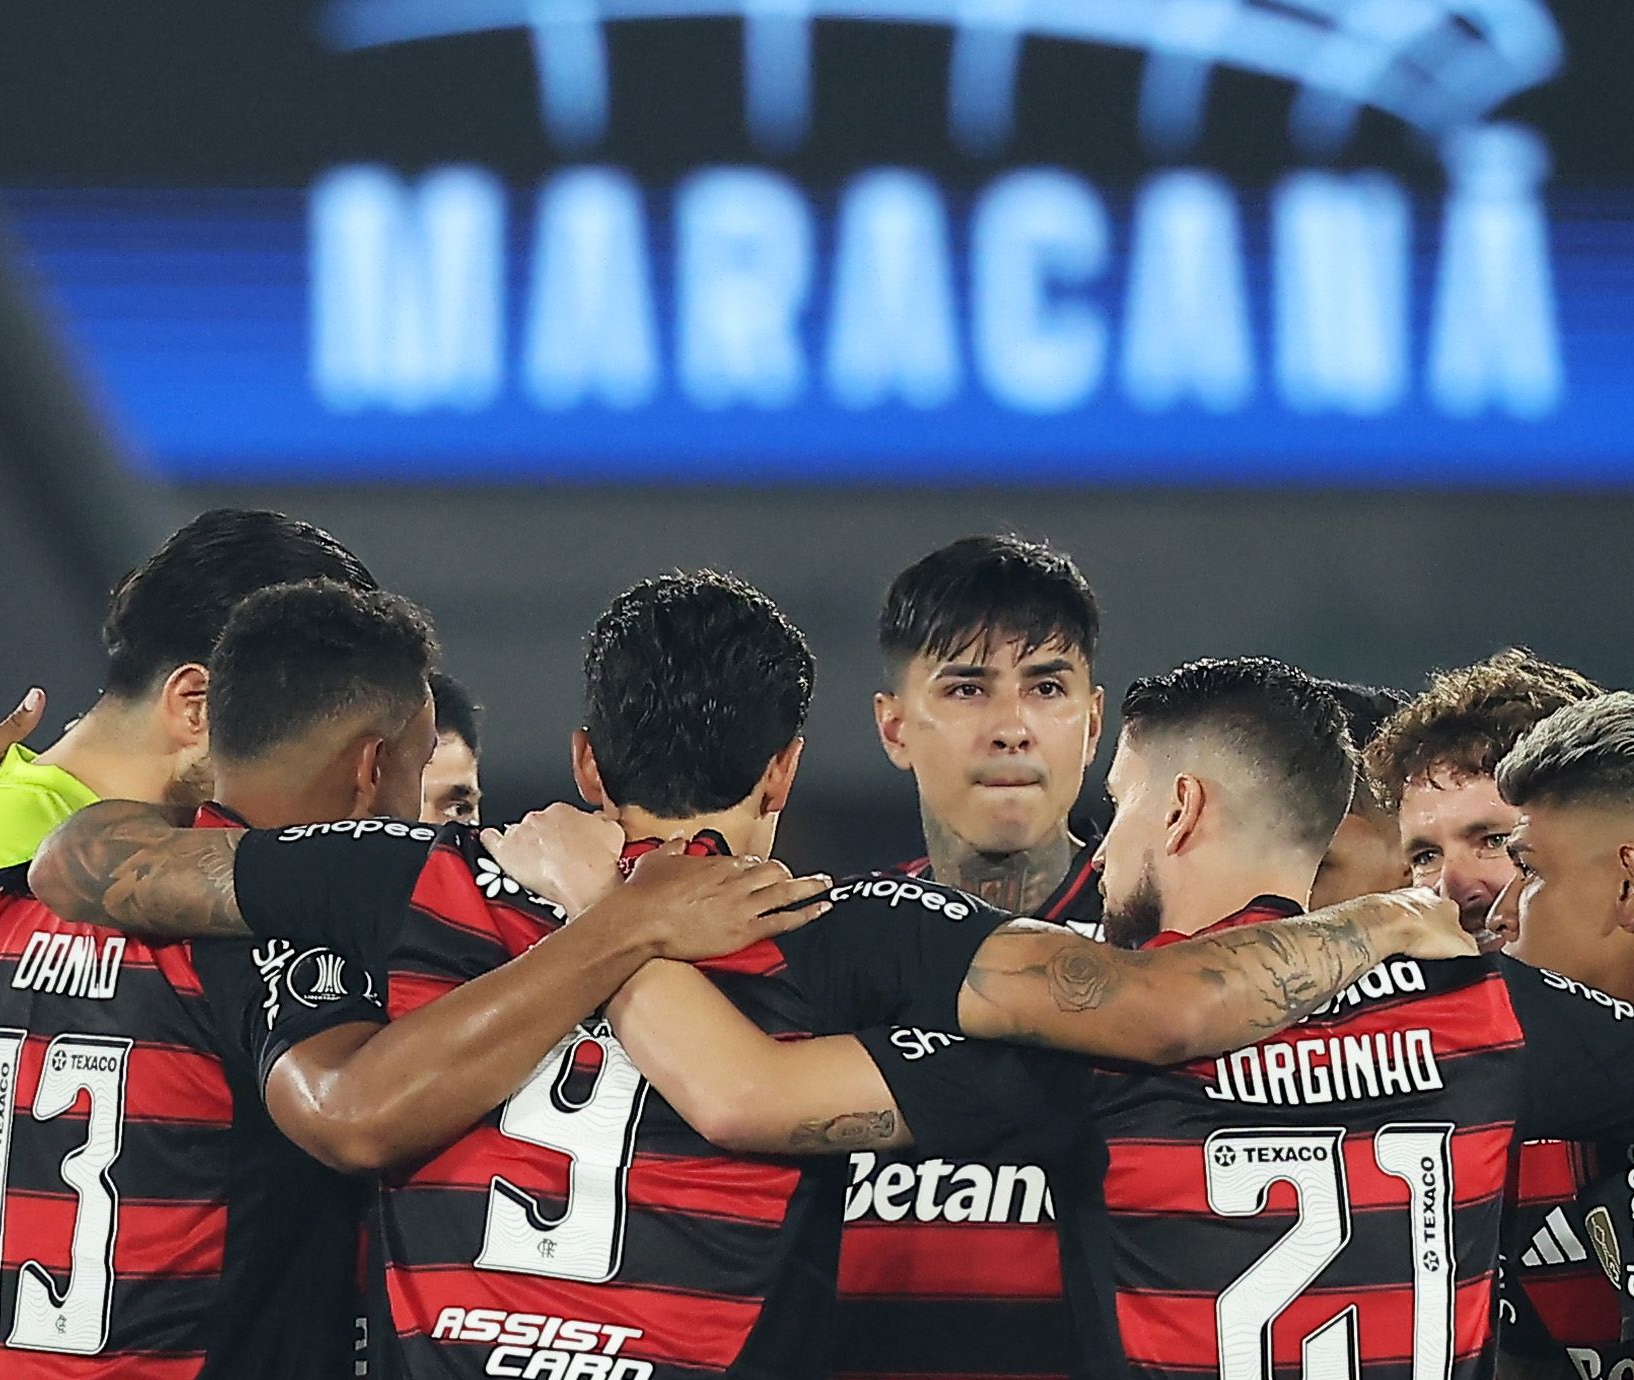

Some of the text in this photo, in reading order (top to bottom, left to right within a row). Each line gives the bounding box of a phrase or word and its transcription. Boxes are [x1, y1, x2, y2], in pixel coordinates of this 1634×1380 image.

[11, 932, 125, 999] DANILO
[71, 1055, 117, 1072] TEXACO
[1205, 1029, 1443, 1104] JORGINHO
[472, 1020, 650, 1284] 9
[1243, 1146, 1328, 1163] TEXACO
[844, 1152, 1056, 1224] Betan
[1421, 1156, 1436, 1243] TEXACO
[432, 1306, 643, 1357] ASSIST
